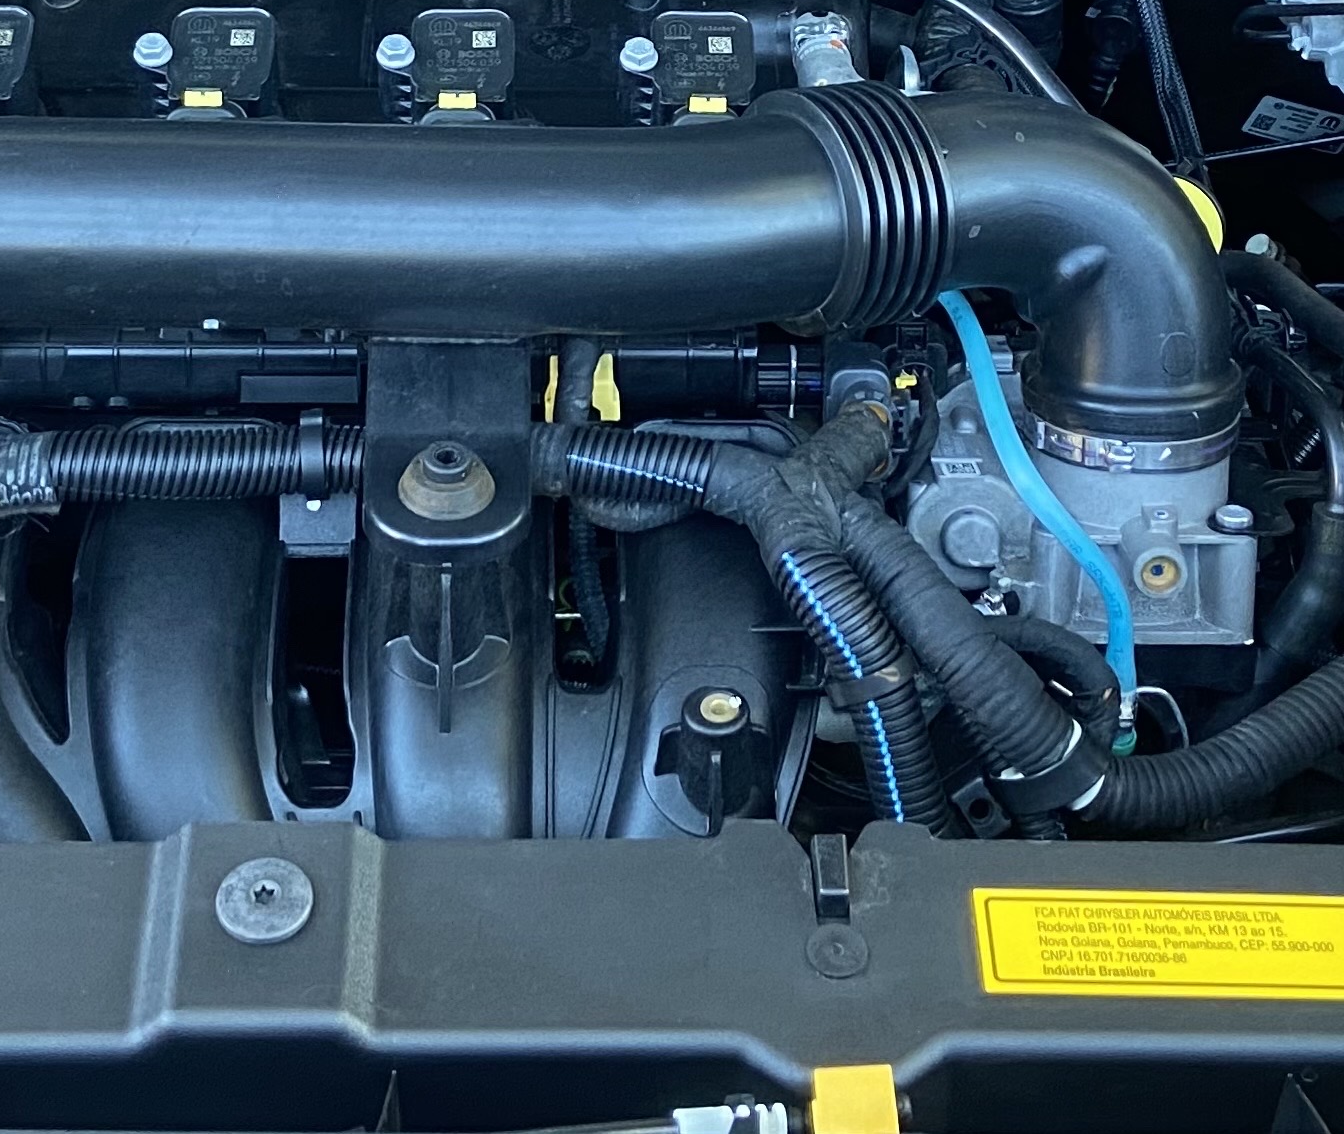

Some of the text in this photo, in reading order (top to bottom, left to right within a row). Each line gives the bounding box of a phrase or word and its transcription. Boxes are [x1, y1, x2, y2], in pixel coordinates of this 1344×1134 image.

[215, 48, 257, 56] BOSCH
[458, 50, 499, 58] BOSCH
[696, 55, 737, 63] BOSCH
[1035, 907, 1055, 918] FCA
[1058, 907, 1080, 919] FIAT
[1083, 907, 1141, 920] CHRYSLER
[1143, 907, 1212, 922] AUTOMÓVEIS
[1214, 910, 1252, 922] BRASIL
[1037, 921, 1086, 933] Rodovia
[1088, 922, 1133, 934] BR-101
[1144, 923, 1181, 936] Norte,
[1209, 925, 1230, 936] KM
[1233, 926, 1248, 937] 13
[1250, 928, 1265, 937] ao
[1039, 935, 1335, 953] Nova Goiana, Goiana, Pernambuco, CEP: 55.900-000
[1041, 949, 1074, 962] CNPJ
[1043, 964, 1156, 978] Indústria Brasileira
